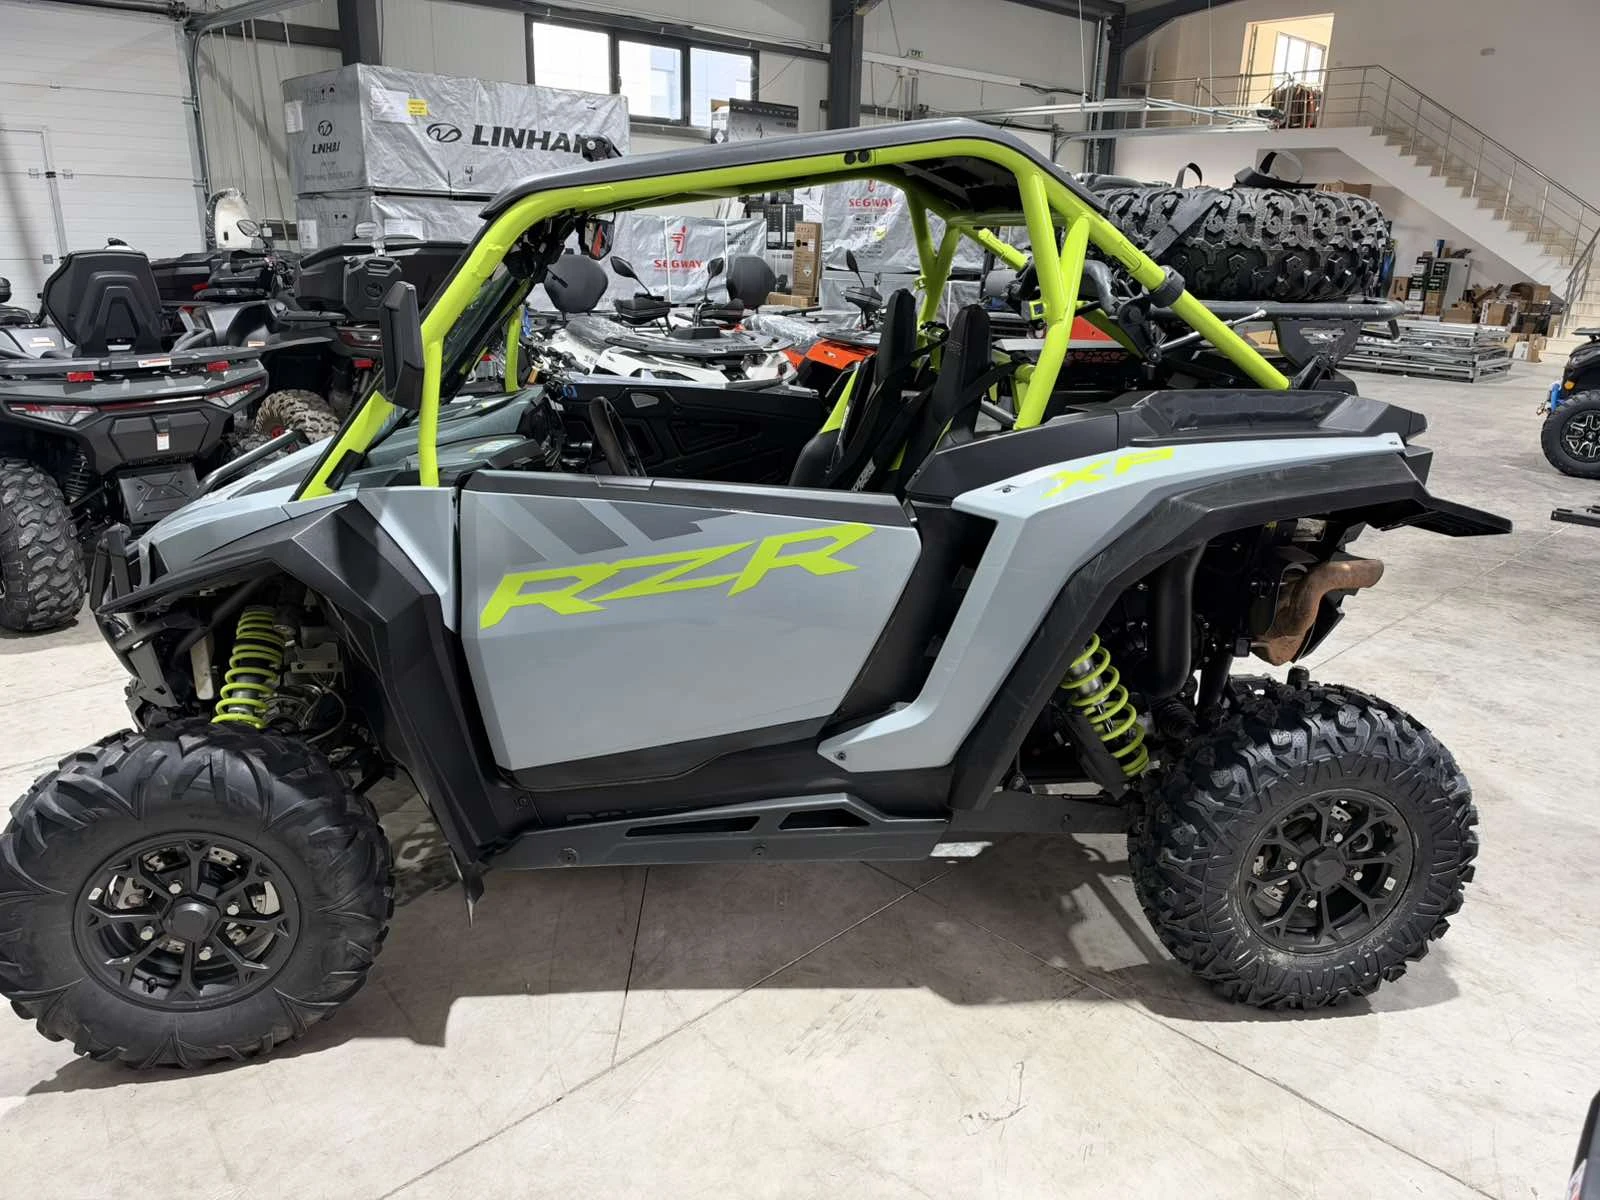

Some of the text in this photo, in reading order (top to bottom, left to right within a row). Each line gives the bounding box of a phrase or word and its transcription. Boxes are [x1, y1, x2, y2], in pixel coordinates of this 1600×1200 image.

[312, 141, 341, 154] LNHAI
[1041, 448, 1174, 499] XP
[479, 522, 876, 631] RZR
